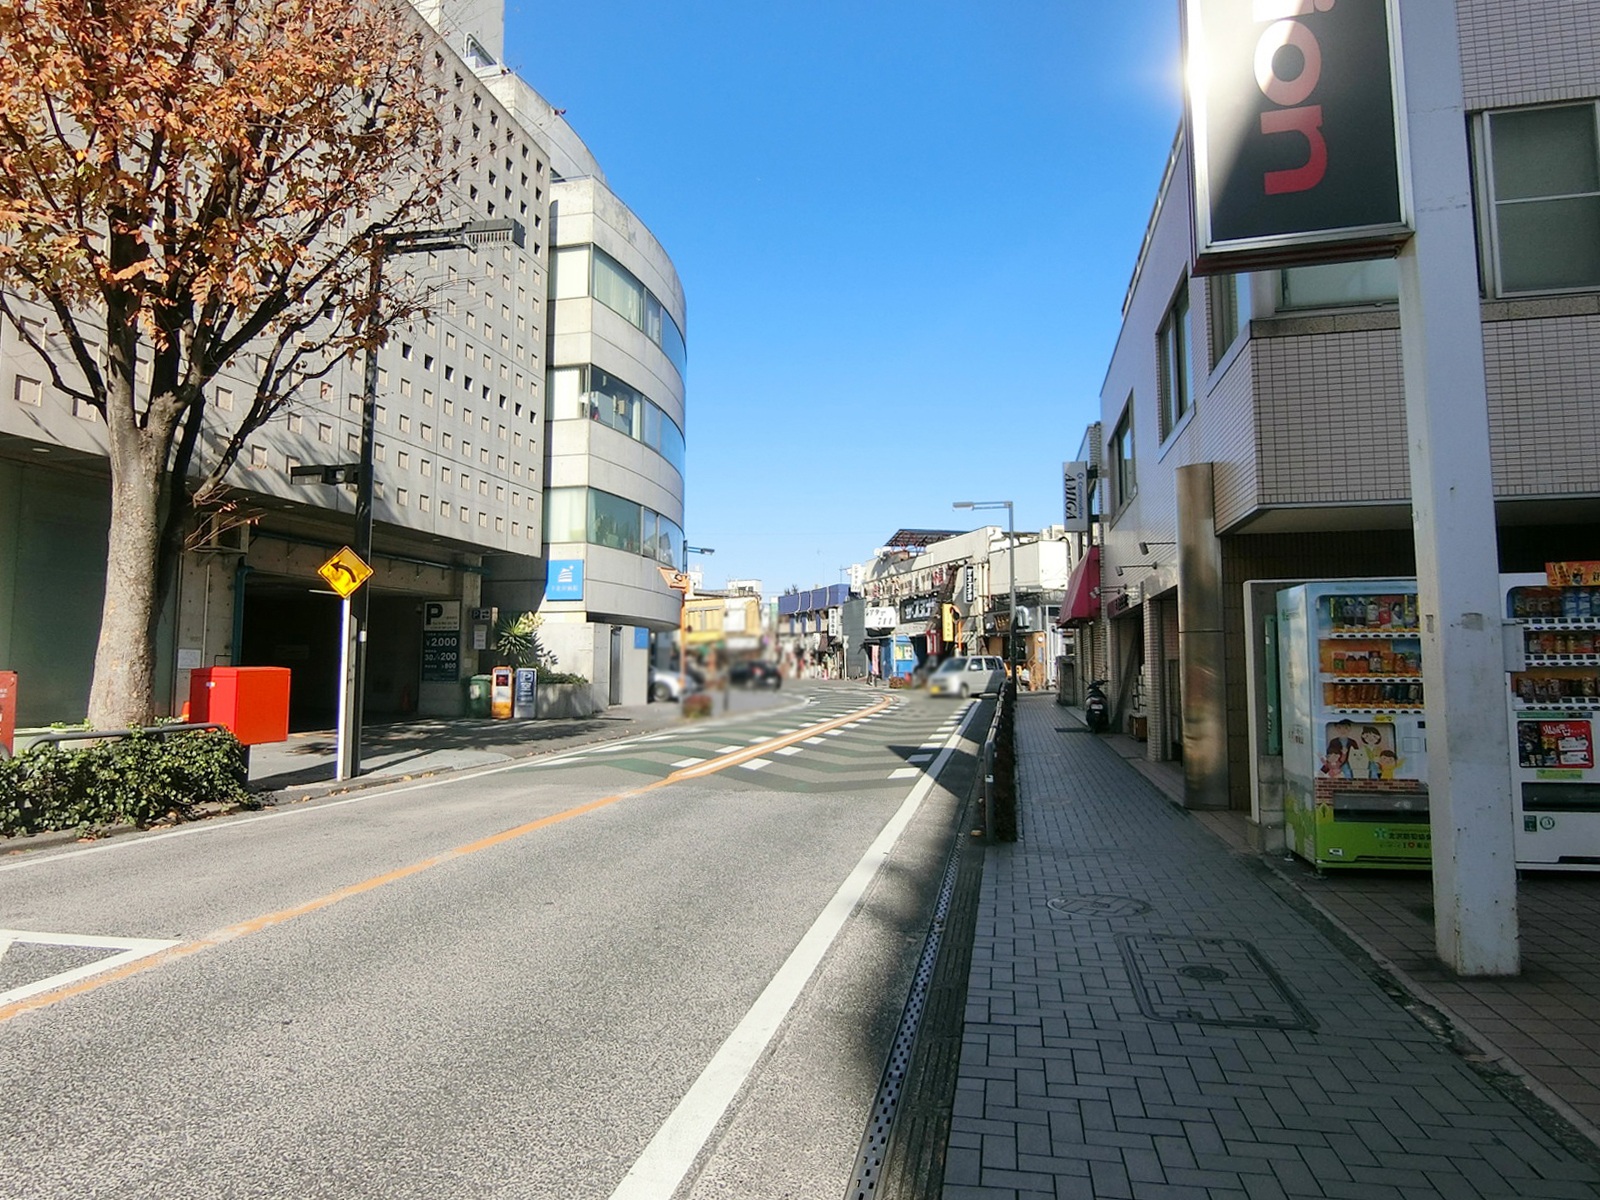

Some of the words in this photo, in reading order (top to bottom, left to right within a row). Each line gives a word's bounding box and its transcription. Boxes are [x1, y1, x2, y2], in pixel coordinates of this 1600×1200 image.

[1065, 473, 1077, 520] AMIGA
[426, 603, 443, 625] P
[473, 610, 480, 620] P
